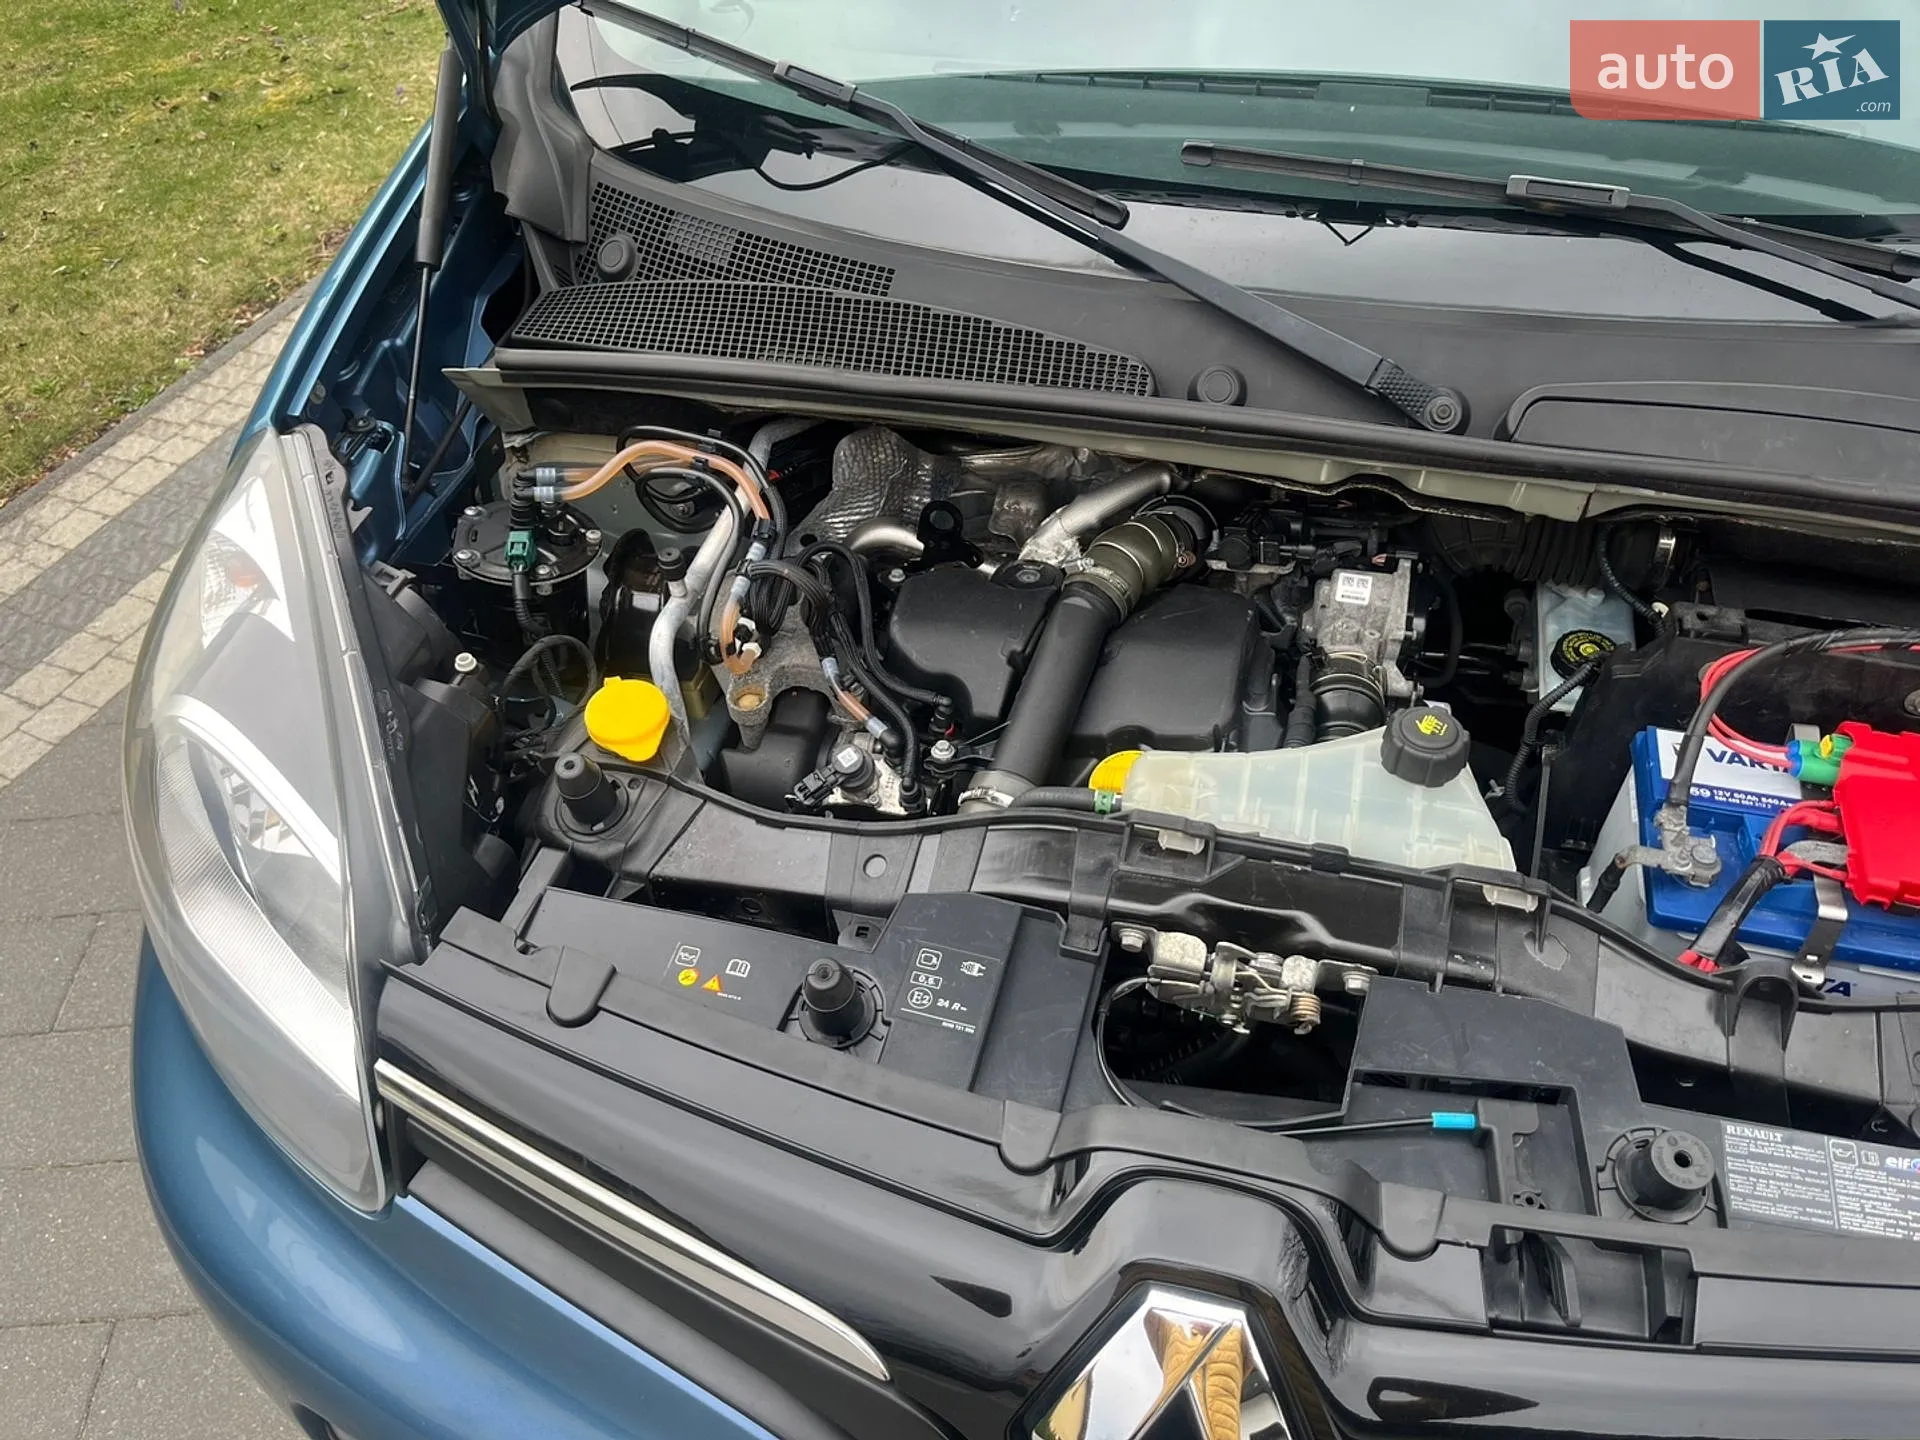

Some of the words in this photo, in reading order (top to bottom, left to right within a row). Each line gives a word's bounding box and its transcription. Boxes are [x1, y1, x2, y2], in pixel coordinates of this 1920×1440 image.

[911, 991, 930, 1004] E2
[937, 998, 950, 1008] 24
[1726, 1124, 1783, 1142] RENAULT
